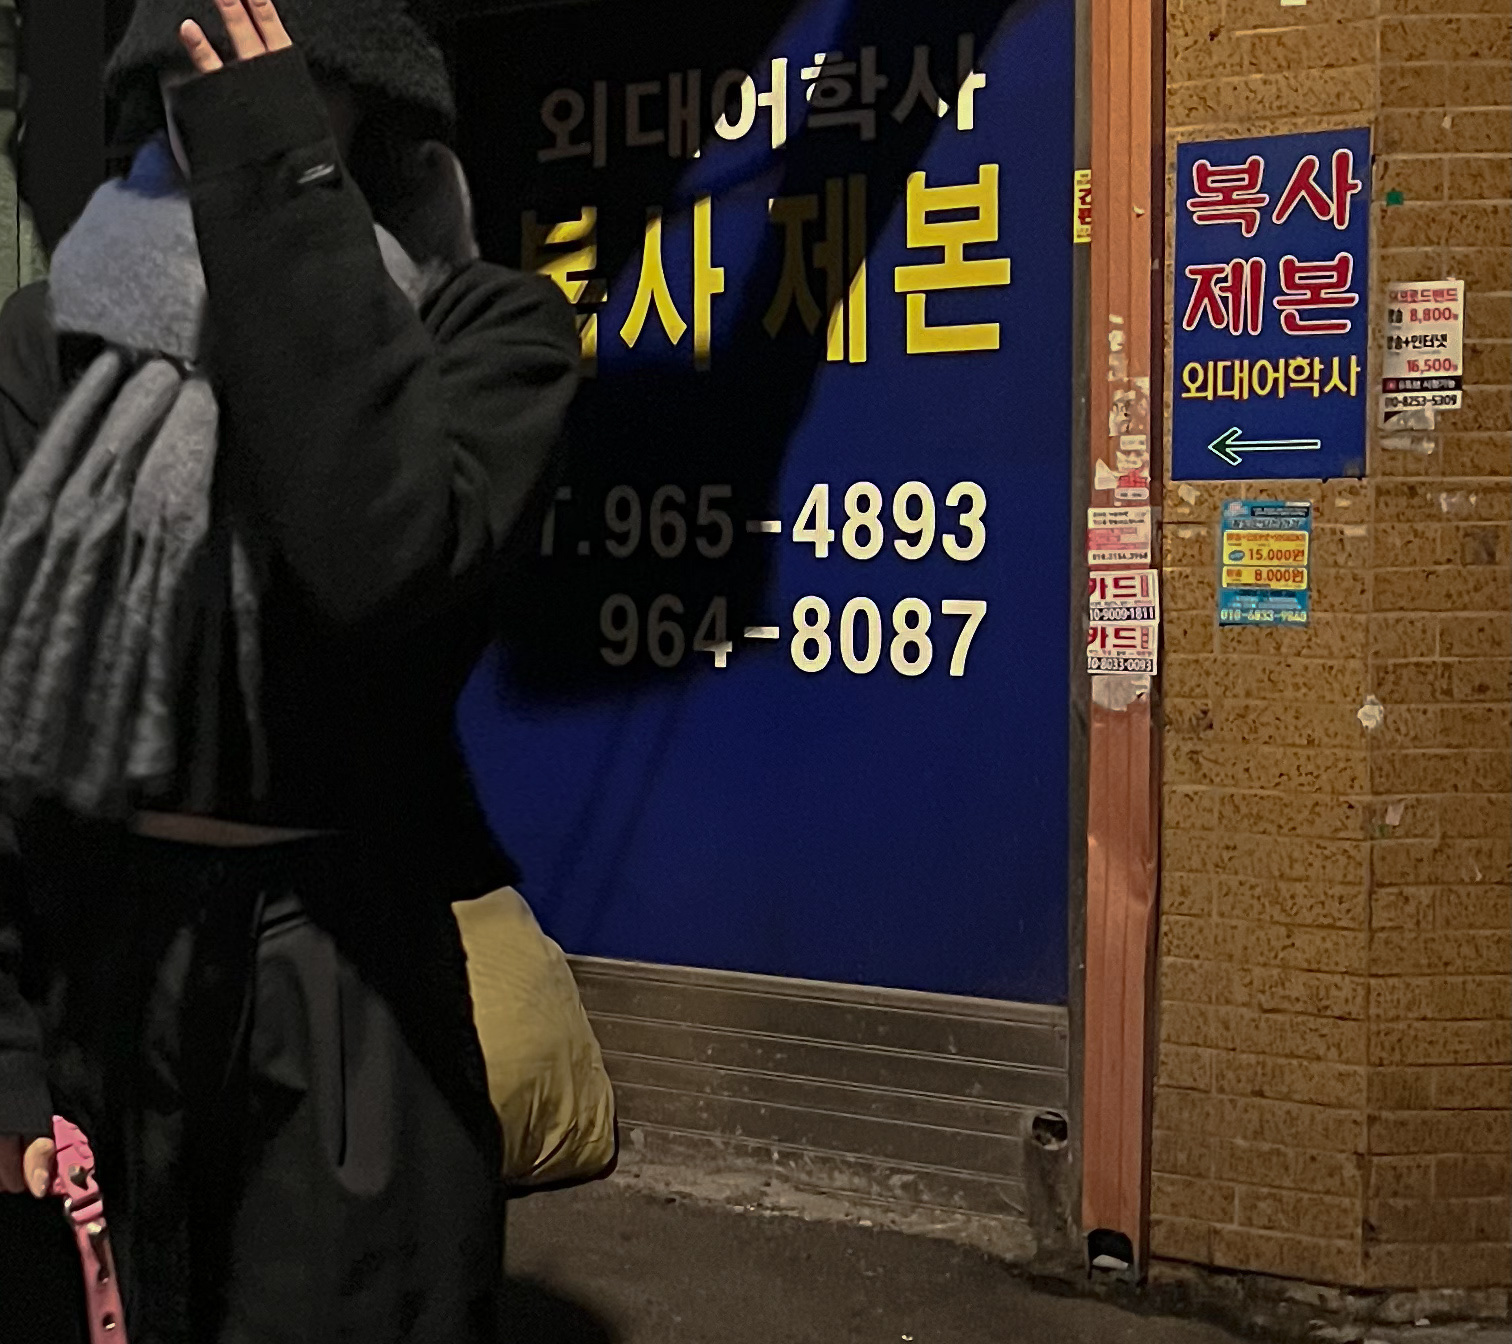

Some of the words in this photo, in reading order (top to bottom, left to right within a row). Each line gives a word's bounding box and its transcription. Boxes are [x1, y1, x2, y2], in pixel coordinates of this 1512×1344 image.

[537, 32, 986, 168] 외대어학사
[1187, 148, 1362, 238] 복사
[1182, 251, 1360, 336] 제본
[1181, 355, 1361, 401] 외대어학사
[597, 595, 988, 677] 964-8087
